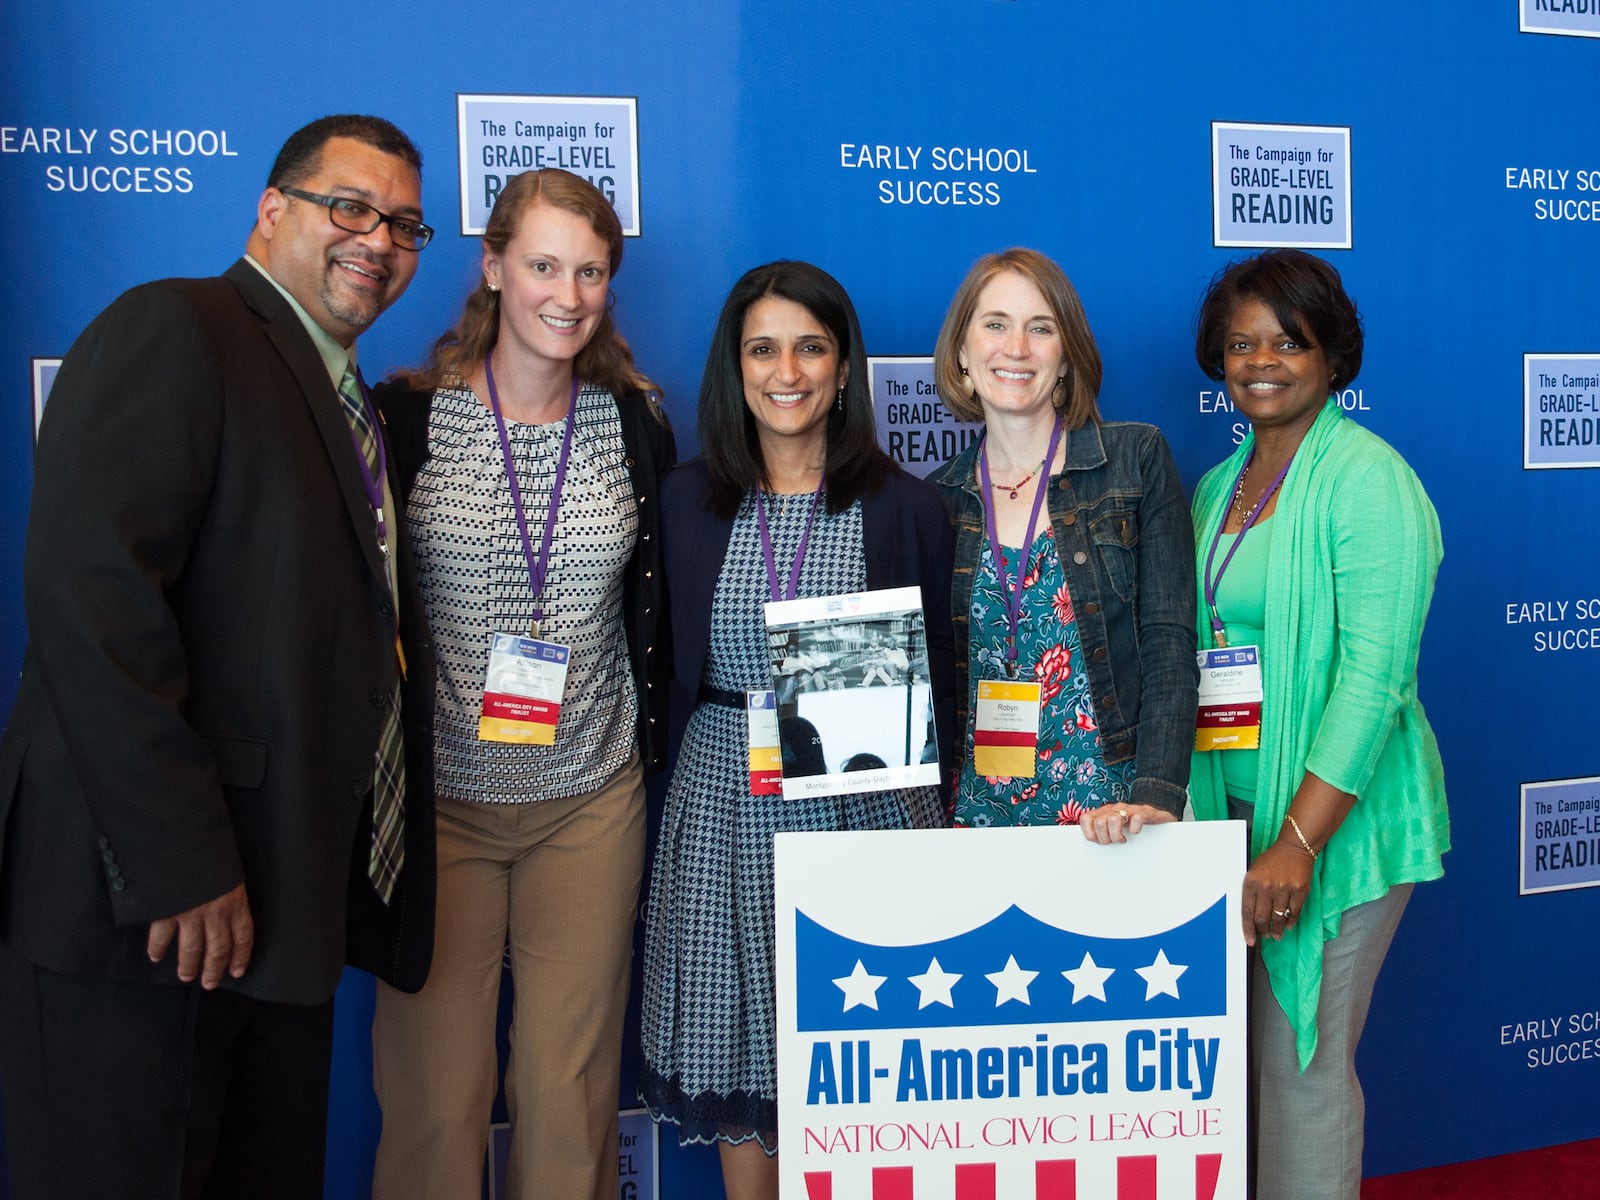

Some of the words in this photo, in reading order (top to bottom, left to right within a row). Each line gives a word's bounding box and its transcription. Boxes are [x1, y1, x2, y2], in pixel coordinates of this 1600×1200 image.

[1, 127, 98, 154] EARLY
[109, 129, 239, 156] SCHOOL
[480, 120, 507, 137] The
[514, 120, 587, 142] Campaign
[594, 122, 616, 138] for
[482, 145, 616, 169] GRADE-LEVEL
[840, 143, 922, 170] EARLY
[931, 146, 1037, 173] SCHOOL
[1229, 145, 1250, 160] The
[1256, 146, 1312, 165] Campaign
[1317, 148, 1334, 163] for
[46, 165, 194, 193] SUCCESS
[1230, 167, 1334, 189] GRADE-LEVEL
[1505, 167, 1570, 190] EARLY
[878, 179, 1001, 206] SUCCESS
[1231, 193, 1334, 225] READING
[886, 380, 909, 396] The
[1538, 373, 1557, 388] The
[1506, 601, 1569, 624] EARLY
[1210, 669, 1244, 679] Geraldine
[997, 703, 1019, 713] Robyn
[1535, 802, 1553, 815] The
[1500, 1016, 1562, 1046] EARLY
[806, 1033, 1108, 1105] All-America
[1125, 1027, 1221, 1101] City
[618, 1131, 638, 1148] for
[803, 1121, 974, 1155] NATIONAL
[982, 1113, 1077, 1147] CIVIC
[1089, 1108, 1222, 1142] LEAGUE
